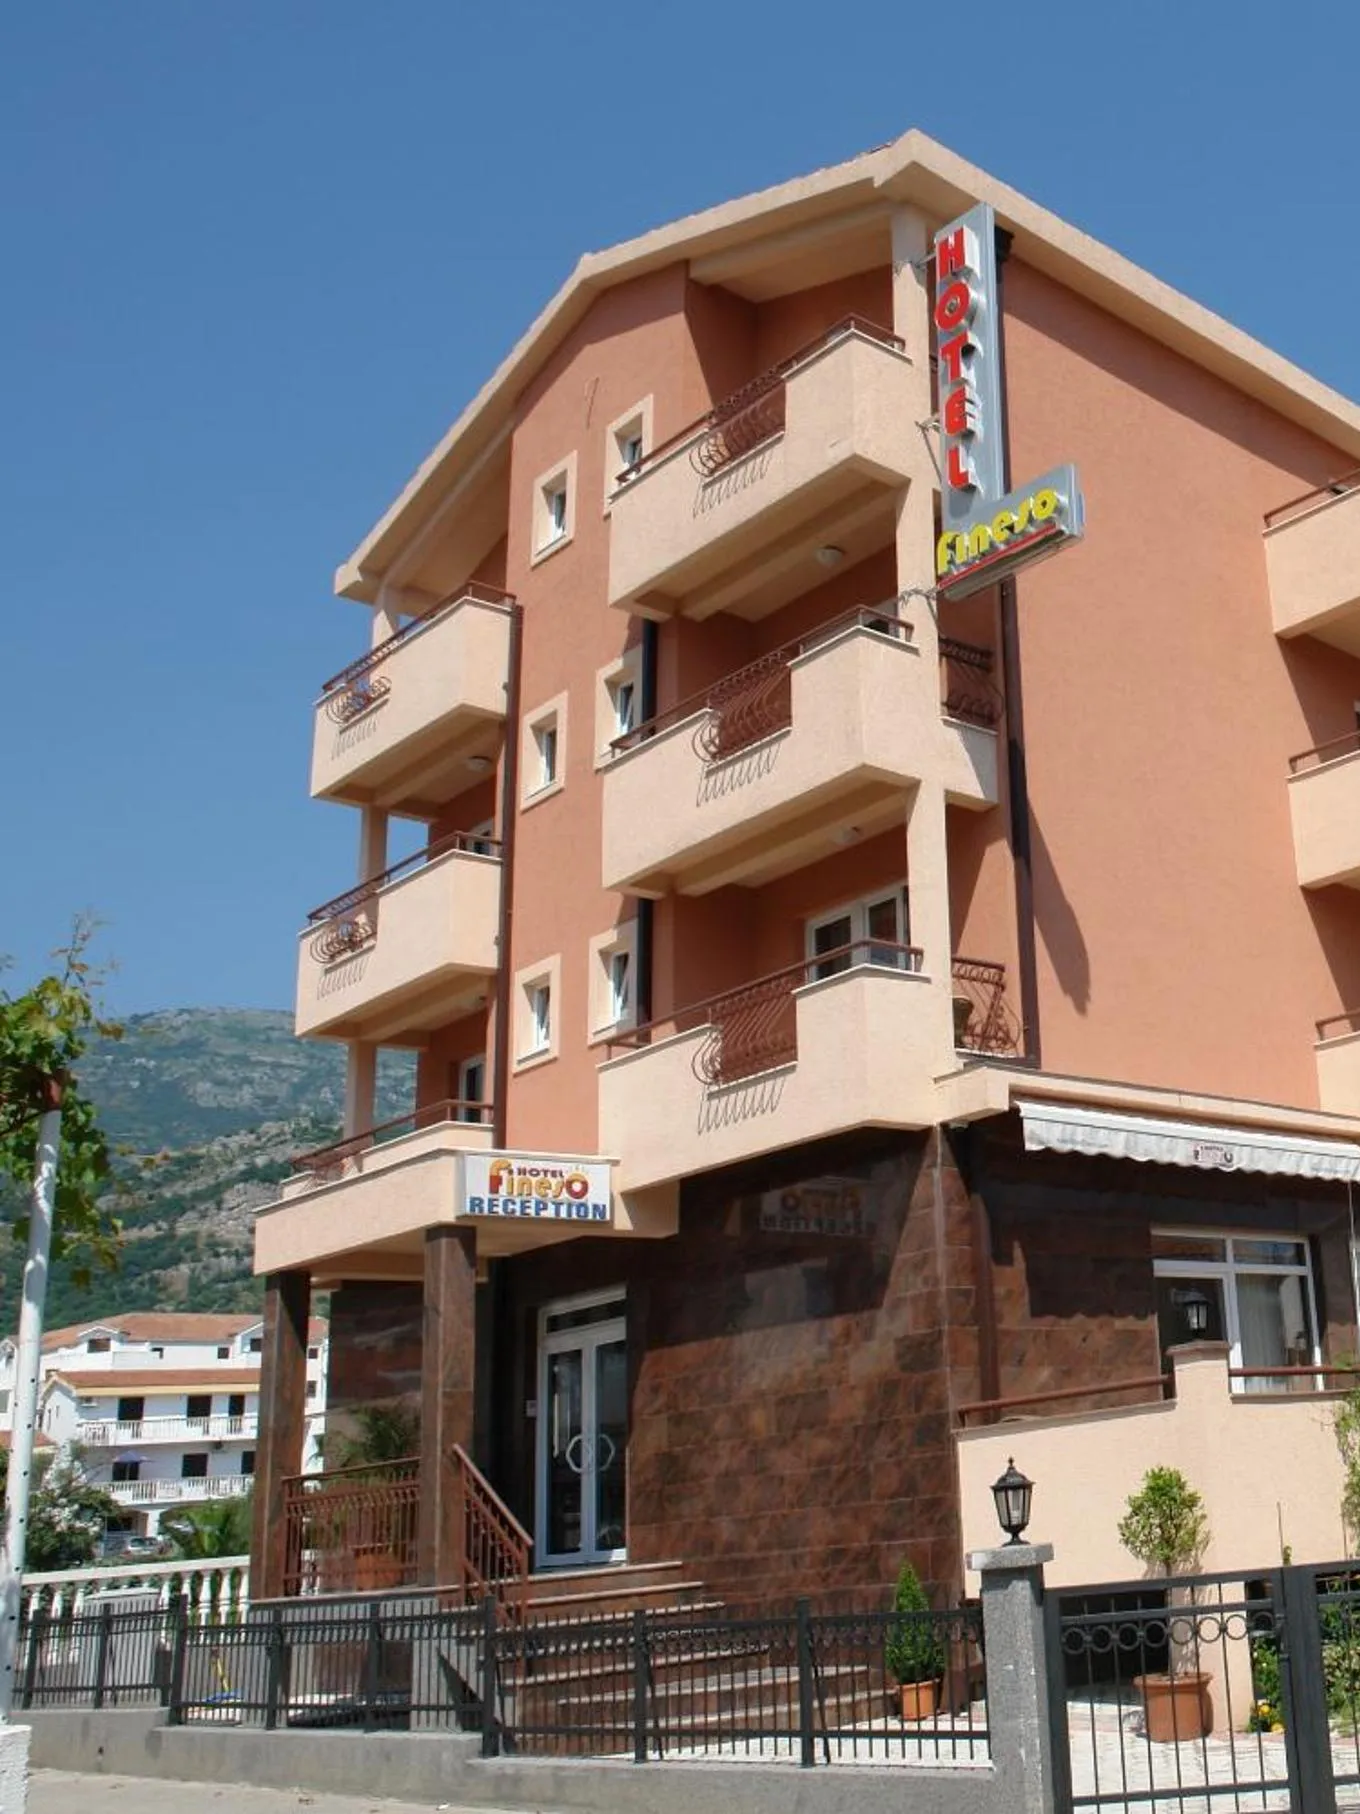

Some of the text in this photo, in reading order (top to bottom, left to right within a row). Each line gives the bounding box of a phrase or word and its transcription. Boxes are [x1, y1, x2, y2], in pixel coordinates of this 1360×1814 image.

[934, 225, 975, 490] HOTEL
[516, 1166, 565, 1179] HOTEL
[469, 1196, 608, 1220] RECEPTION
